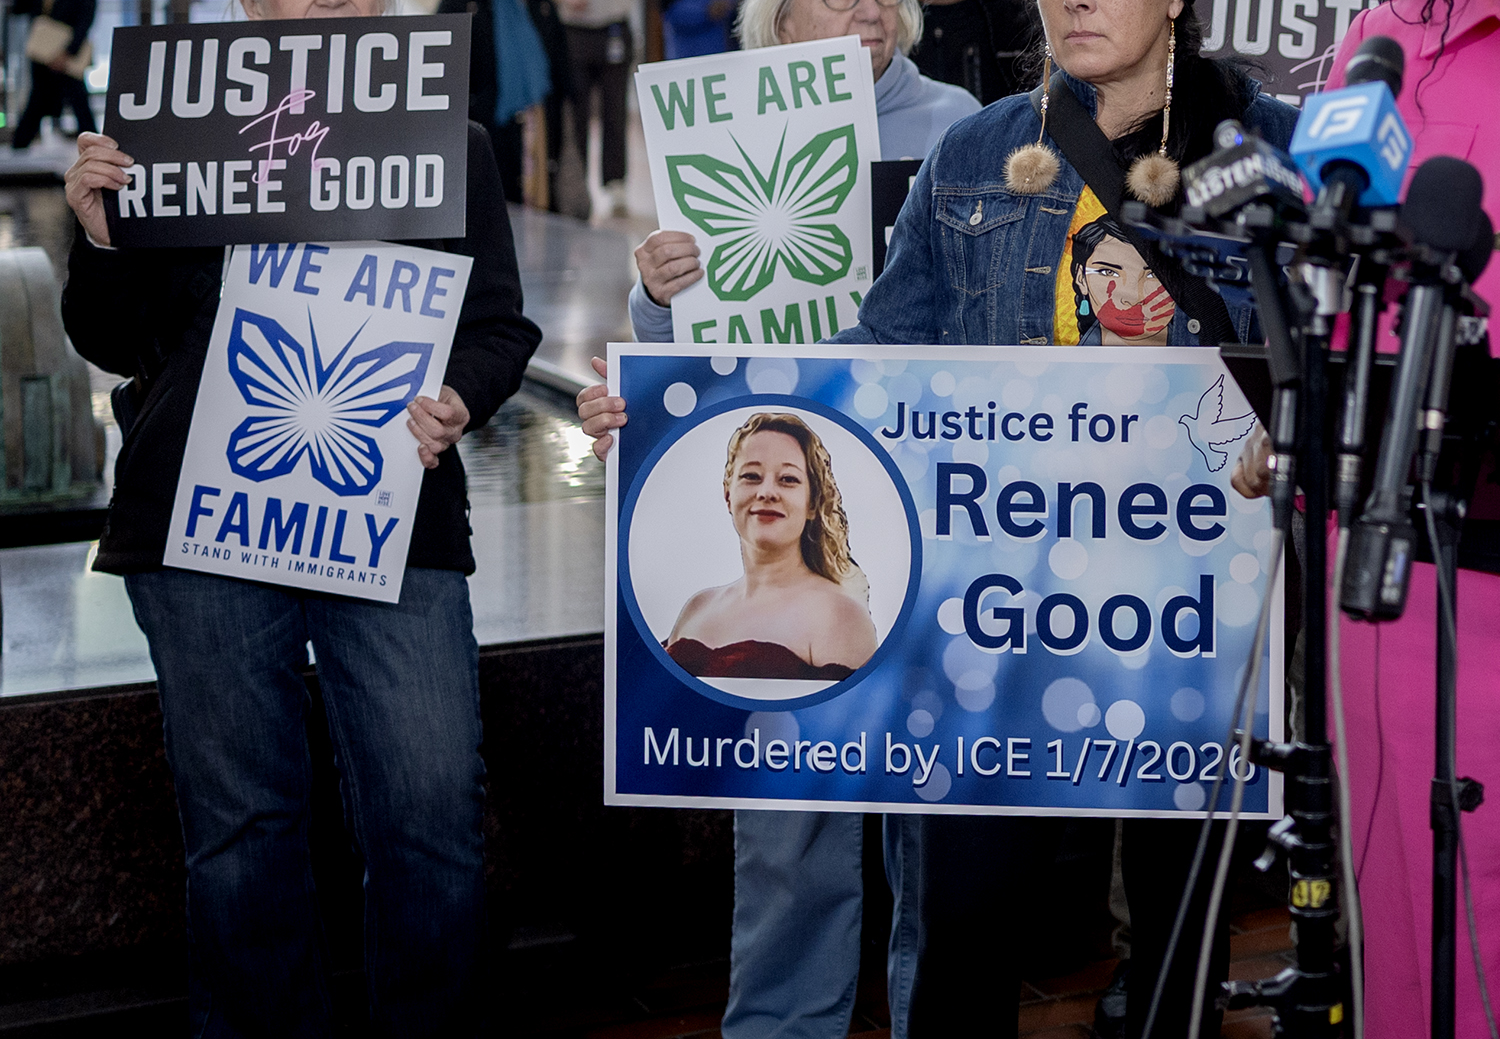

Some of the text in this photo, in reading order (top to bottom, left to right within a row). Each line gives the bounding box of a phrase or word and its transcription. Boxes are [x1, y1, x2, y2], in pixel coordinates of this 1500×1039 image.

[118, 30, 452, 121] JUSTICE
[650, 54, 852, 131] WE ARE
[118, 154, 445, 218] RENEE GOOD
[248, 242, 456, 319] WE ARE
[880, 401, 1139, 444] Justice for
[185, 484, 400, 569] FAMILY
[934, 462, 1229, 542] Renee
[181, 542, 388, 587] STAND WITH IMMIGRANTS
[962, 573, 1217, 657] Good
[643, 726, 1258, 787] Murdered by ICE 1/7/2026
